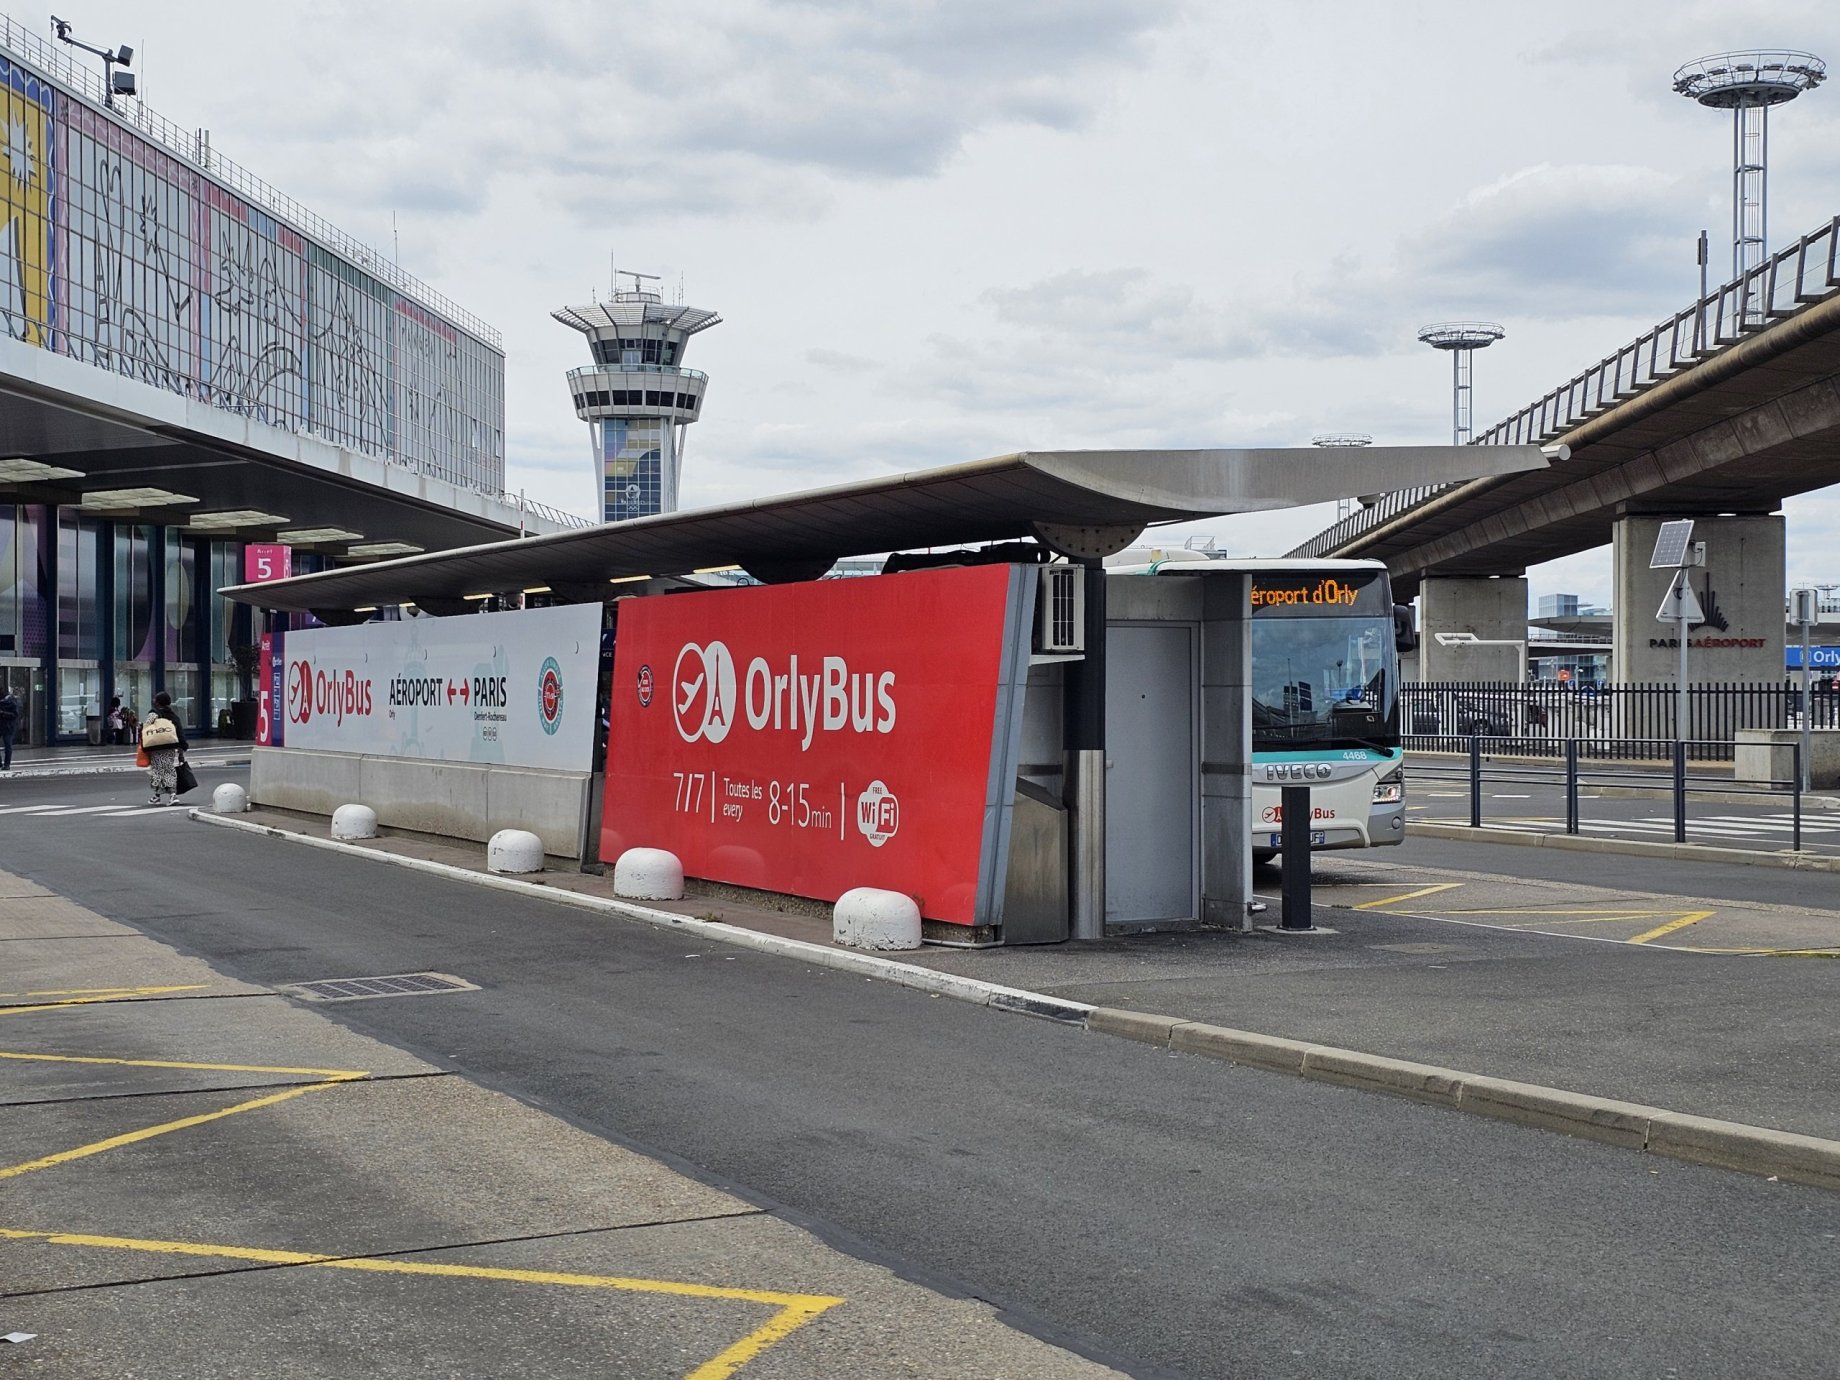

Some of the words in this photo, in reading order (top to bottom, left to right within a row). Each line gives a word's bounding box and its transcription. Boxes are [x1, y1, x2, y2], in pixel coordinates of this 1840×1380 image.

[257, 557, 272, 579] 5
[1312, 580, 1358, 606] d'Orly
[1695, 636, 1766, 648] AÉROPORT
[317, 669, 372, 727] OrlyBus
[389, 673, 443, 706] AÉROPORT
[474, 677, 507, 707] PARIS
[745, 654, 896, 752] OrlyBus
[260, 690, 269, 742] 5
[1342, 752, 1367, 760] 4468
[1266, 763, 1332, 780] IVECO
[673, 772, 705, 814] 7/7
[723, 777, 750, 799] Toutes
[751, 779, 763, 800] les
[872, 786, 883, 795] FREE
[723, 802, 744, 823] every
[768, 780, 810, 828] 8-15
[811, 805, 832, 829] min
